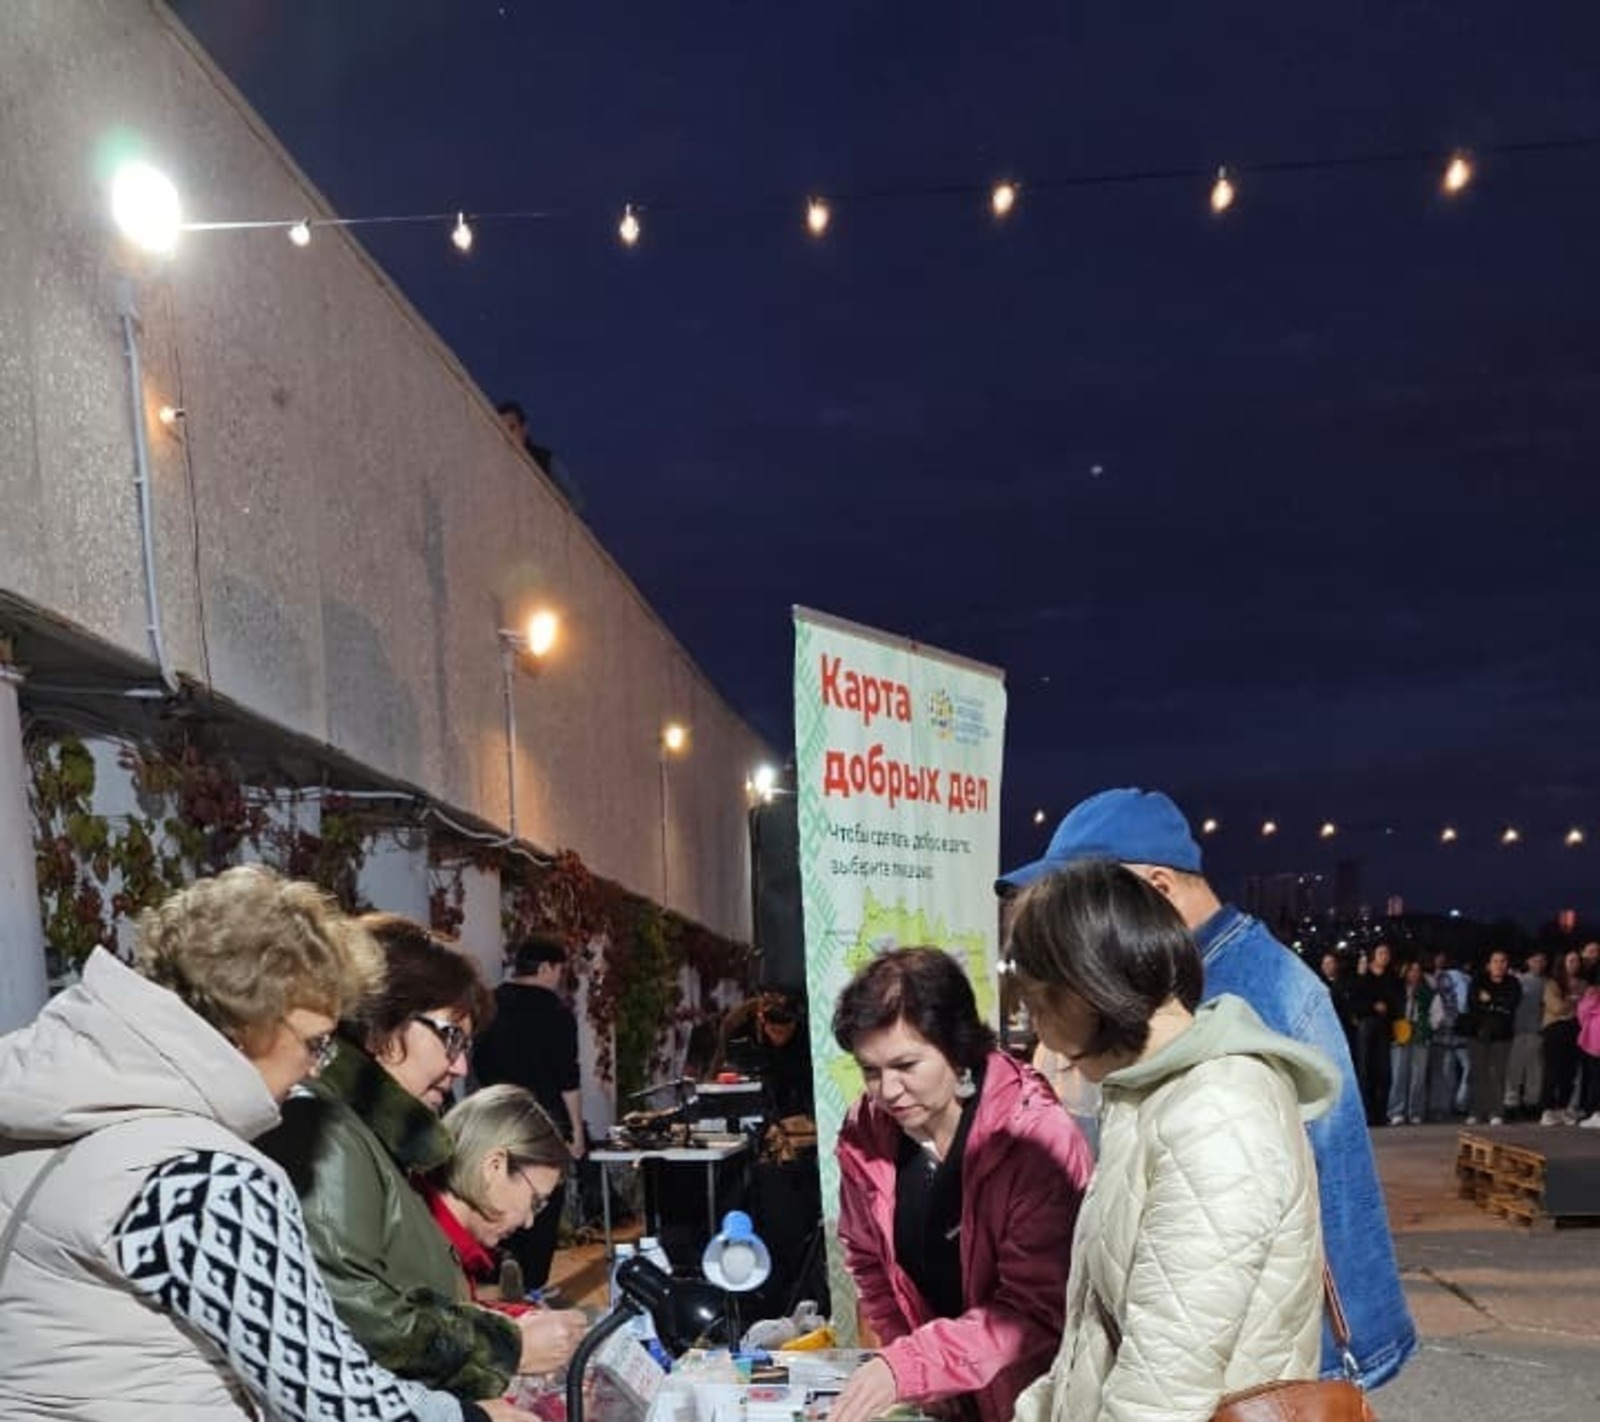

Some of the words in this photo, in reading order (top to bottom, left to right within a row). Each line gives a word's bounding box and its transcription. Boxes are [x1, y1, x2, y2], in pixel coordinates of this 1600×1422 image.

[819, 653, 911, 726] Карта
[824, 744, 941, 808] добрых
[948, 772, 988, 813] дел
